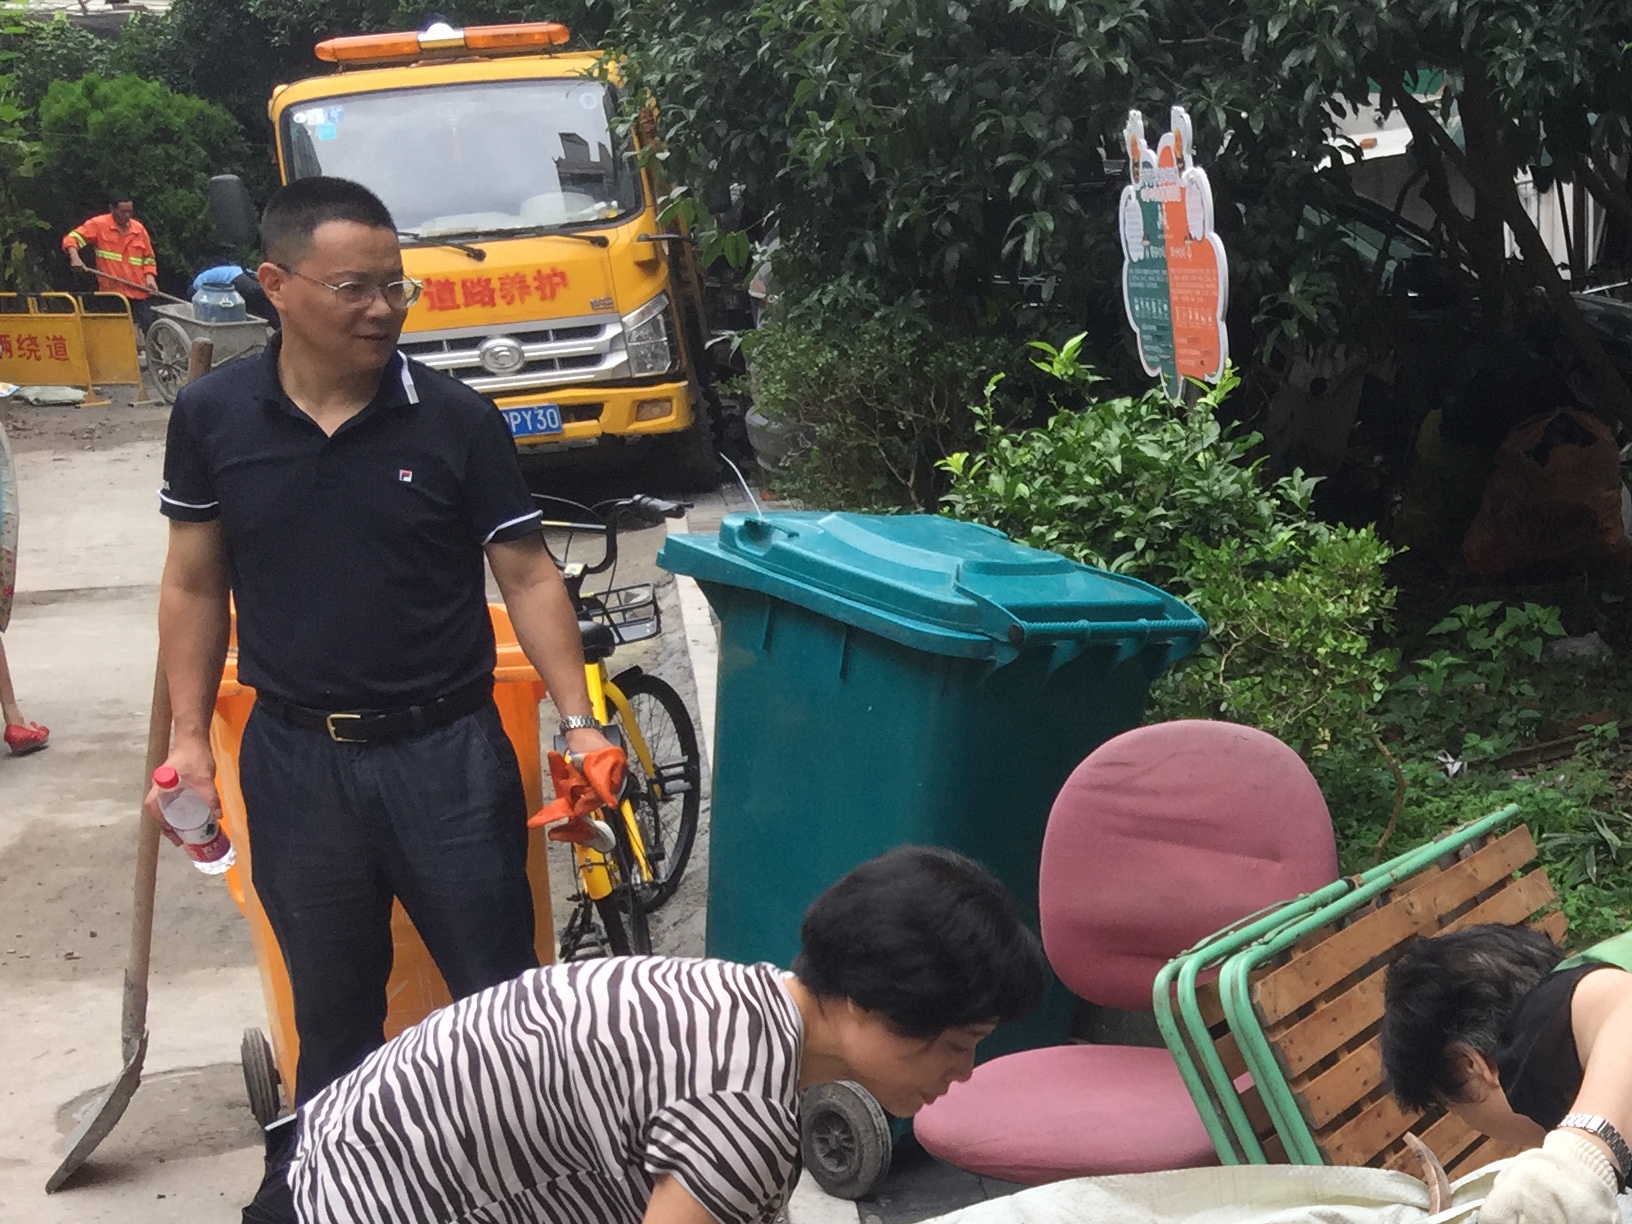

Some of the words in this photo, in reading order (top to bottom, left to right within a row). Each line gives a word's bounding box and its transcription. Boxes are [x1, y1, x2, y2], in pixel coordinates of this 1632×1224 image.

[423, 267, 569, 312] 道路养护
[503, 407, 560, 433] PY30
